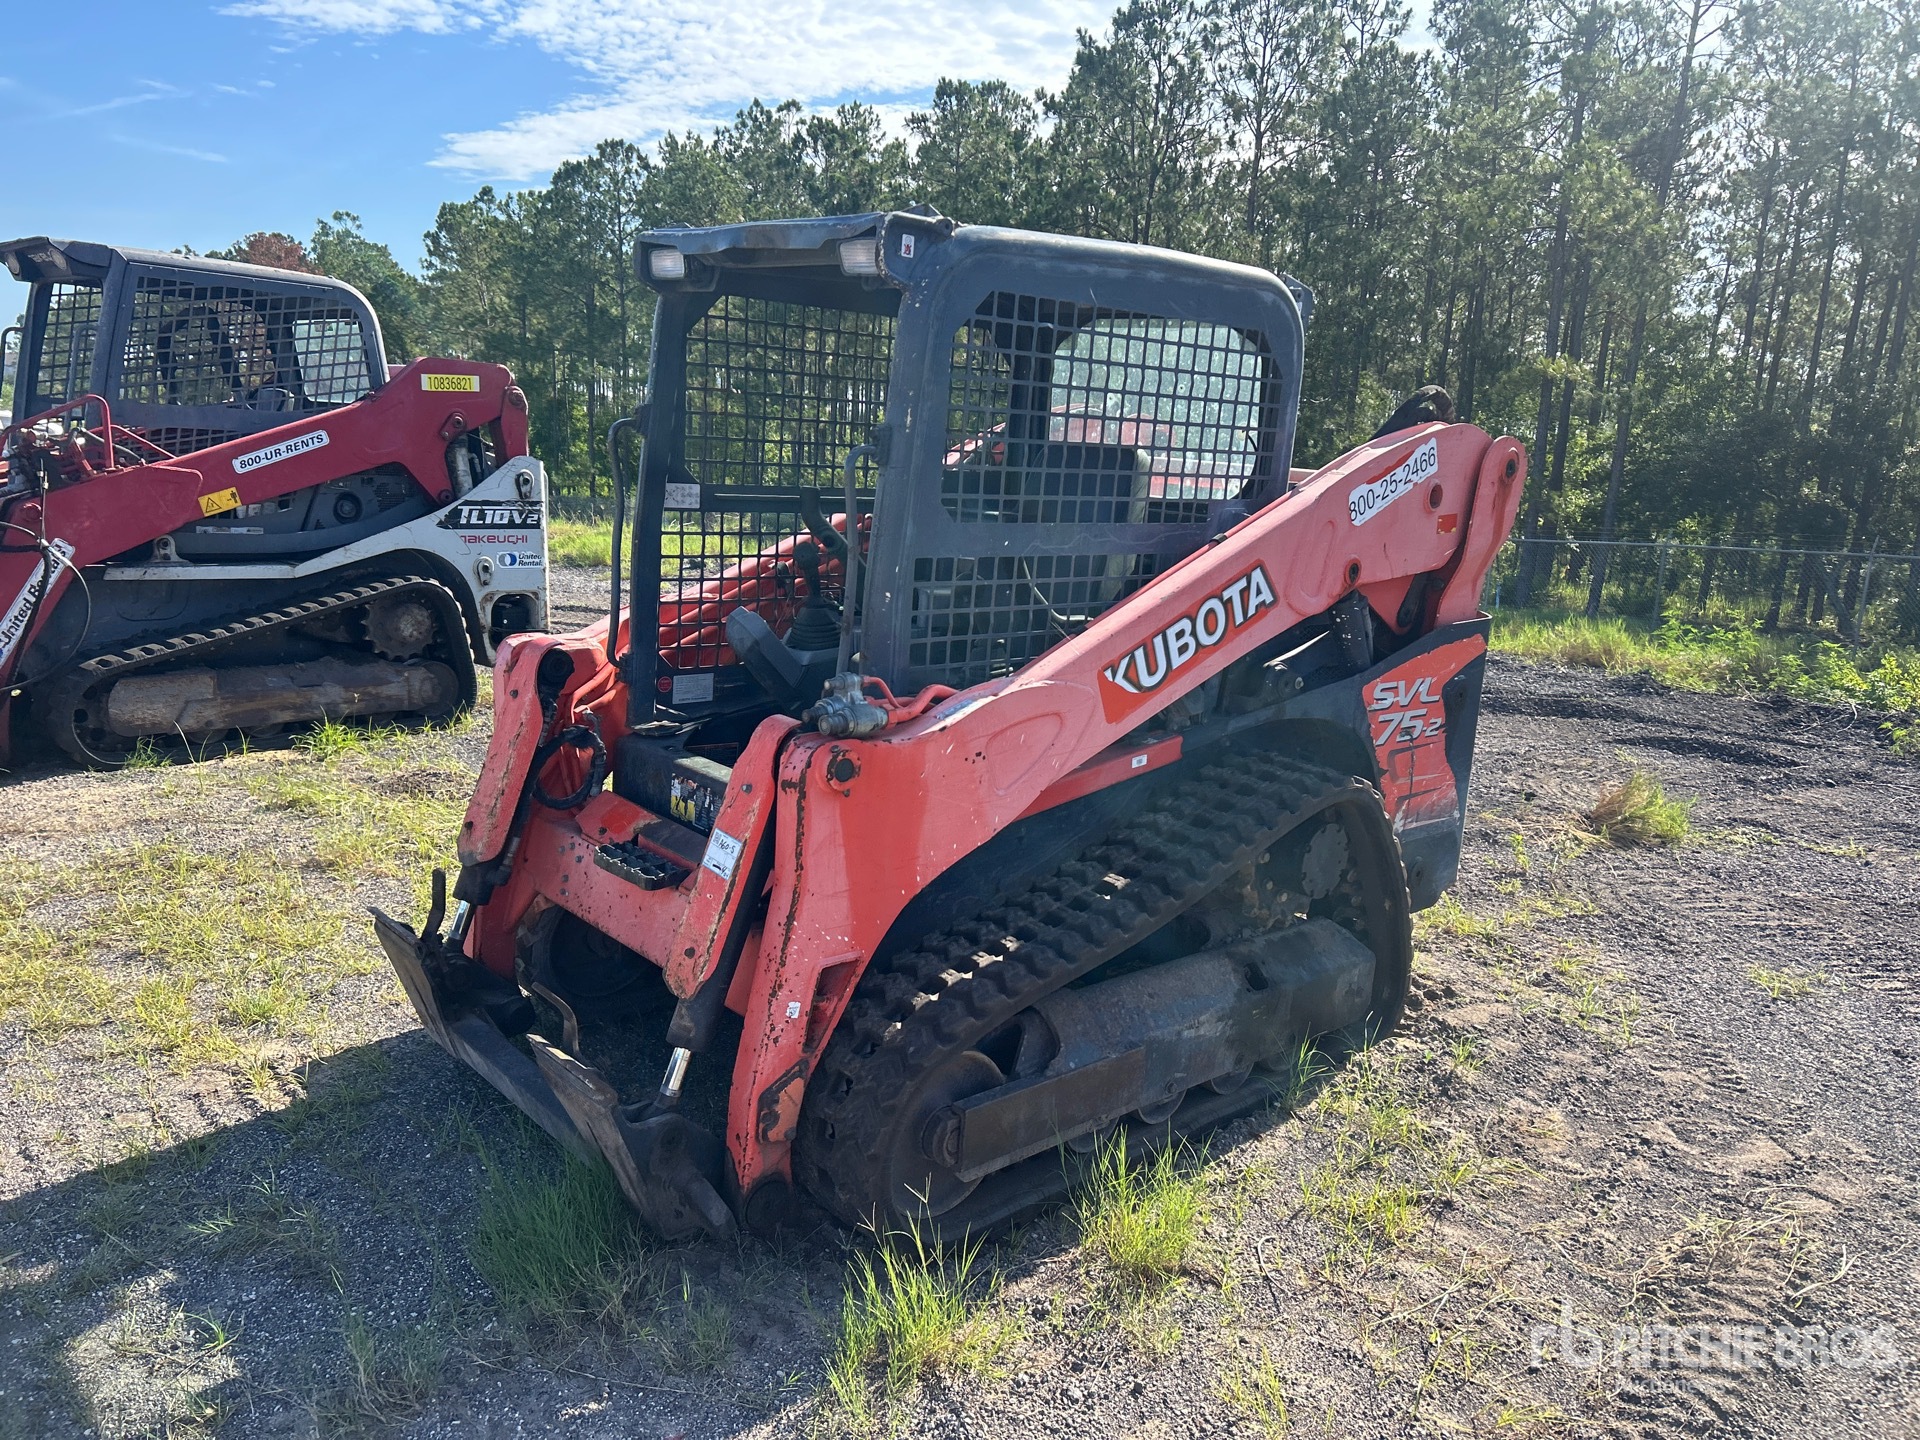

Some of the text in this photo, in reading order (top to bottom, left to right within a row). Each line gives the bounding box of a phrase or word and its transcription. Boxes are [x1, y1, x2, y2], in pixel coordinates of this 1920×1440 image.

[427, 376, 473, 391] 10836821
[239, 434, 325, 469] 800-UR-RENTS
[1349, 447, 1436, 522] 800-25-2466
[1, 597, 33, 649] United
[1103, 566, 1277, 694] KUBOTA
[1369, 677, 1441, 711] SVL
[1375, 708, 1442, 746] 75-2
